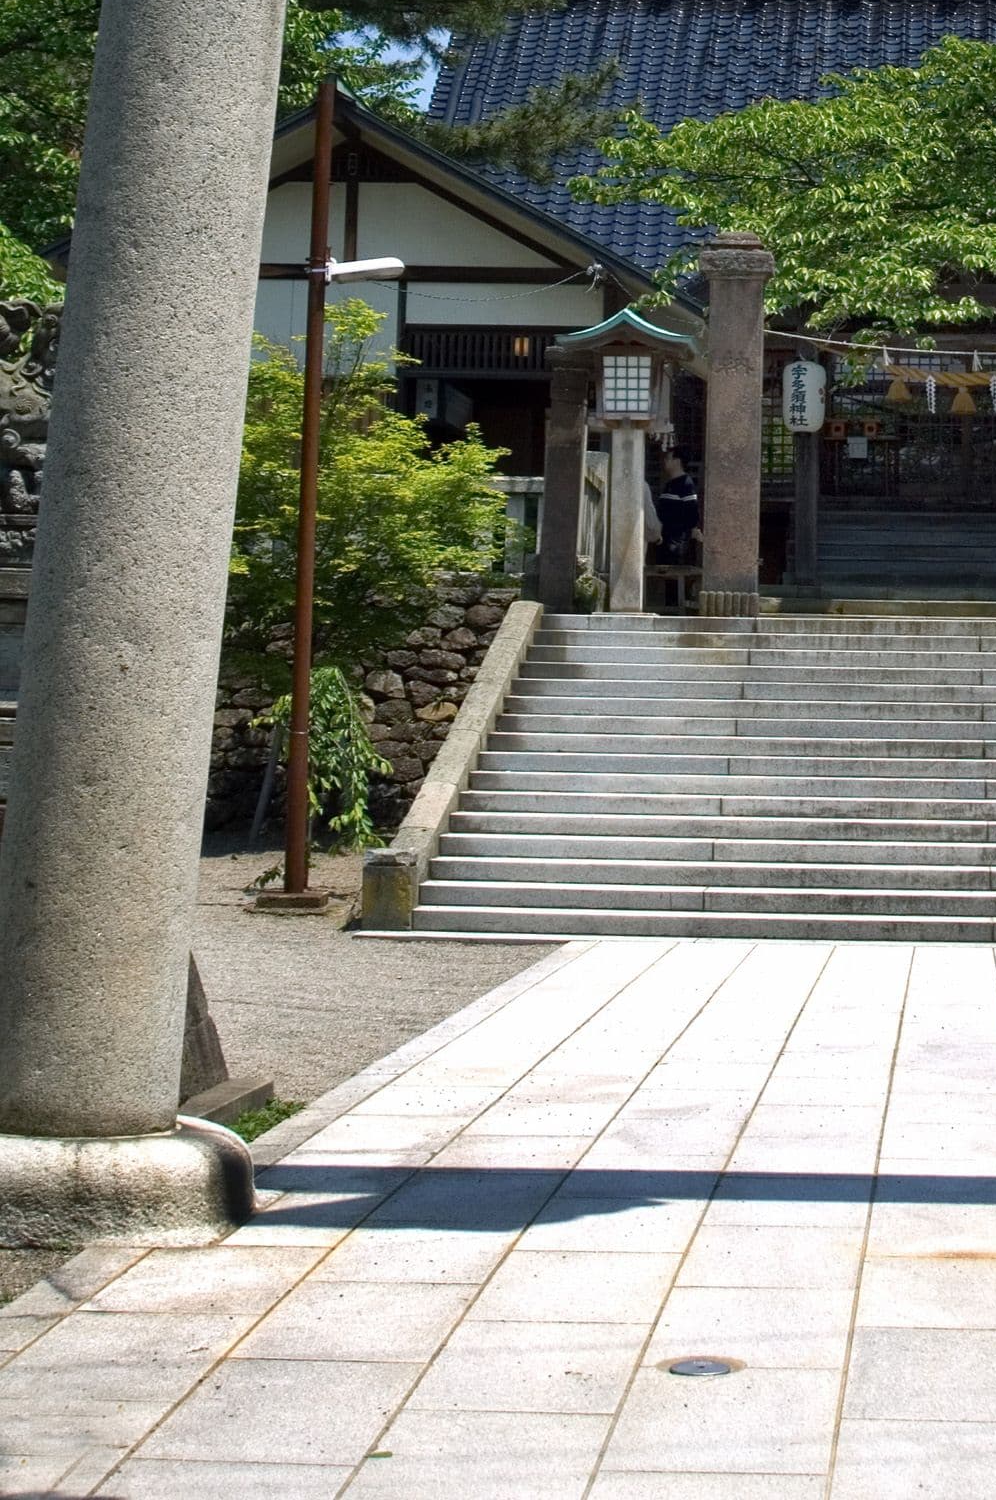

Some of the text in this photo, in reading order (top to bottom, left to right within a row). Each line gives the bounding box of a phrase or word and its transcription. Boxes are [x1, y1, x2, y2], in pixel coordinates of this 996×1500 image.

[789, 365, 809, 427] 宇多須神社
